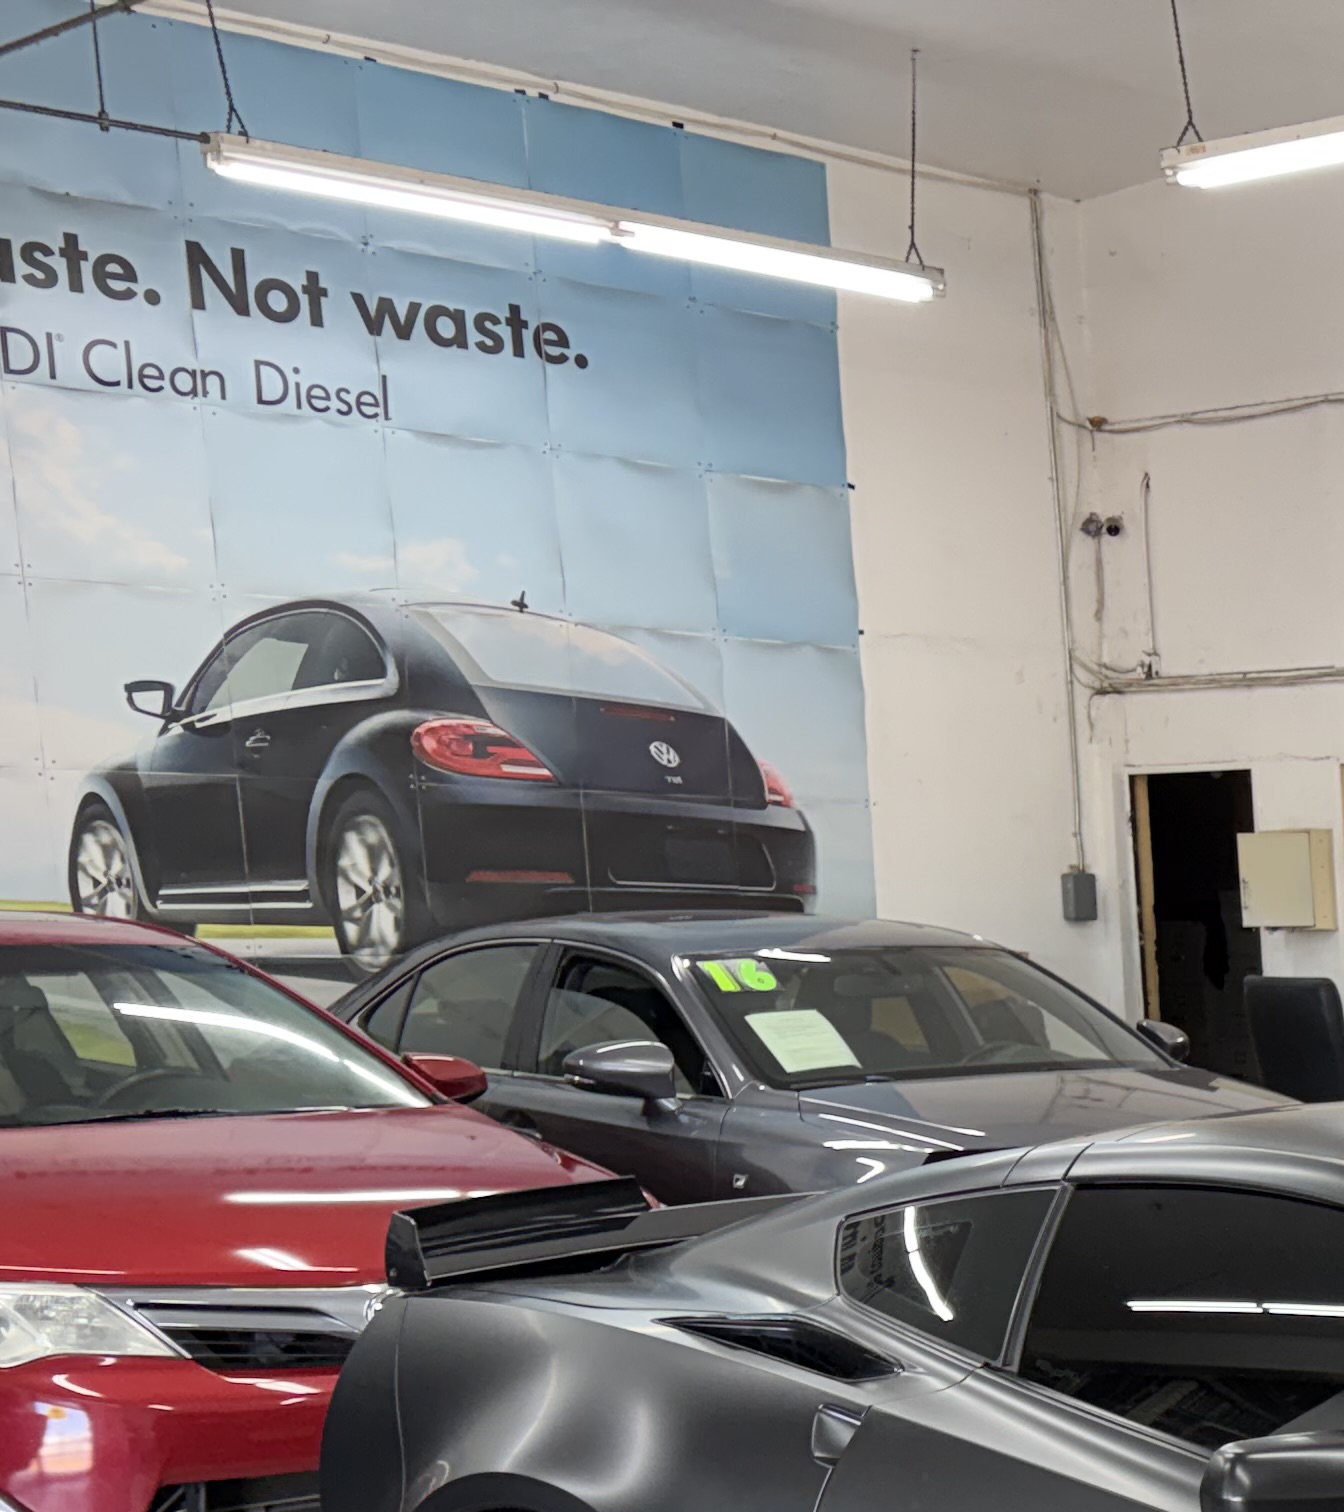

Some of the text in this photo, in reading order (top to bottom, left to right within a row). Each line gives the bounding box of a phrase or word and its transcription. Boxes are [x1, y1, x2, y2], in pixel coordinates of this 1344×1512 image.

[185, 239, 329, 329] Not
[350, 290, 589, 370] waste.
[82, 337, 227, 401] Clean
[254, 358, 392, 421] Diesel
[703, 957, 777, 992] 16
